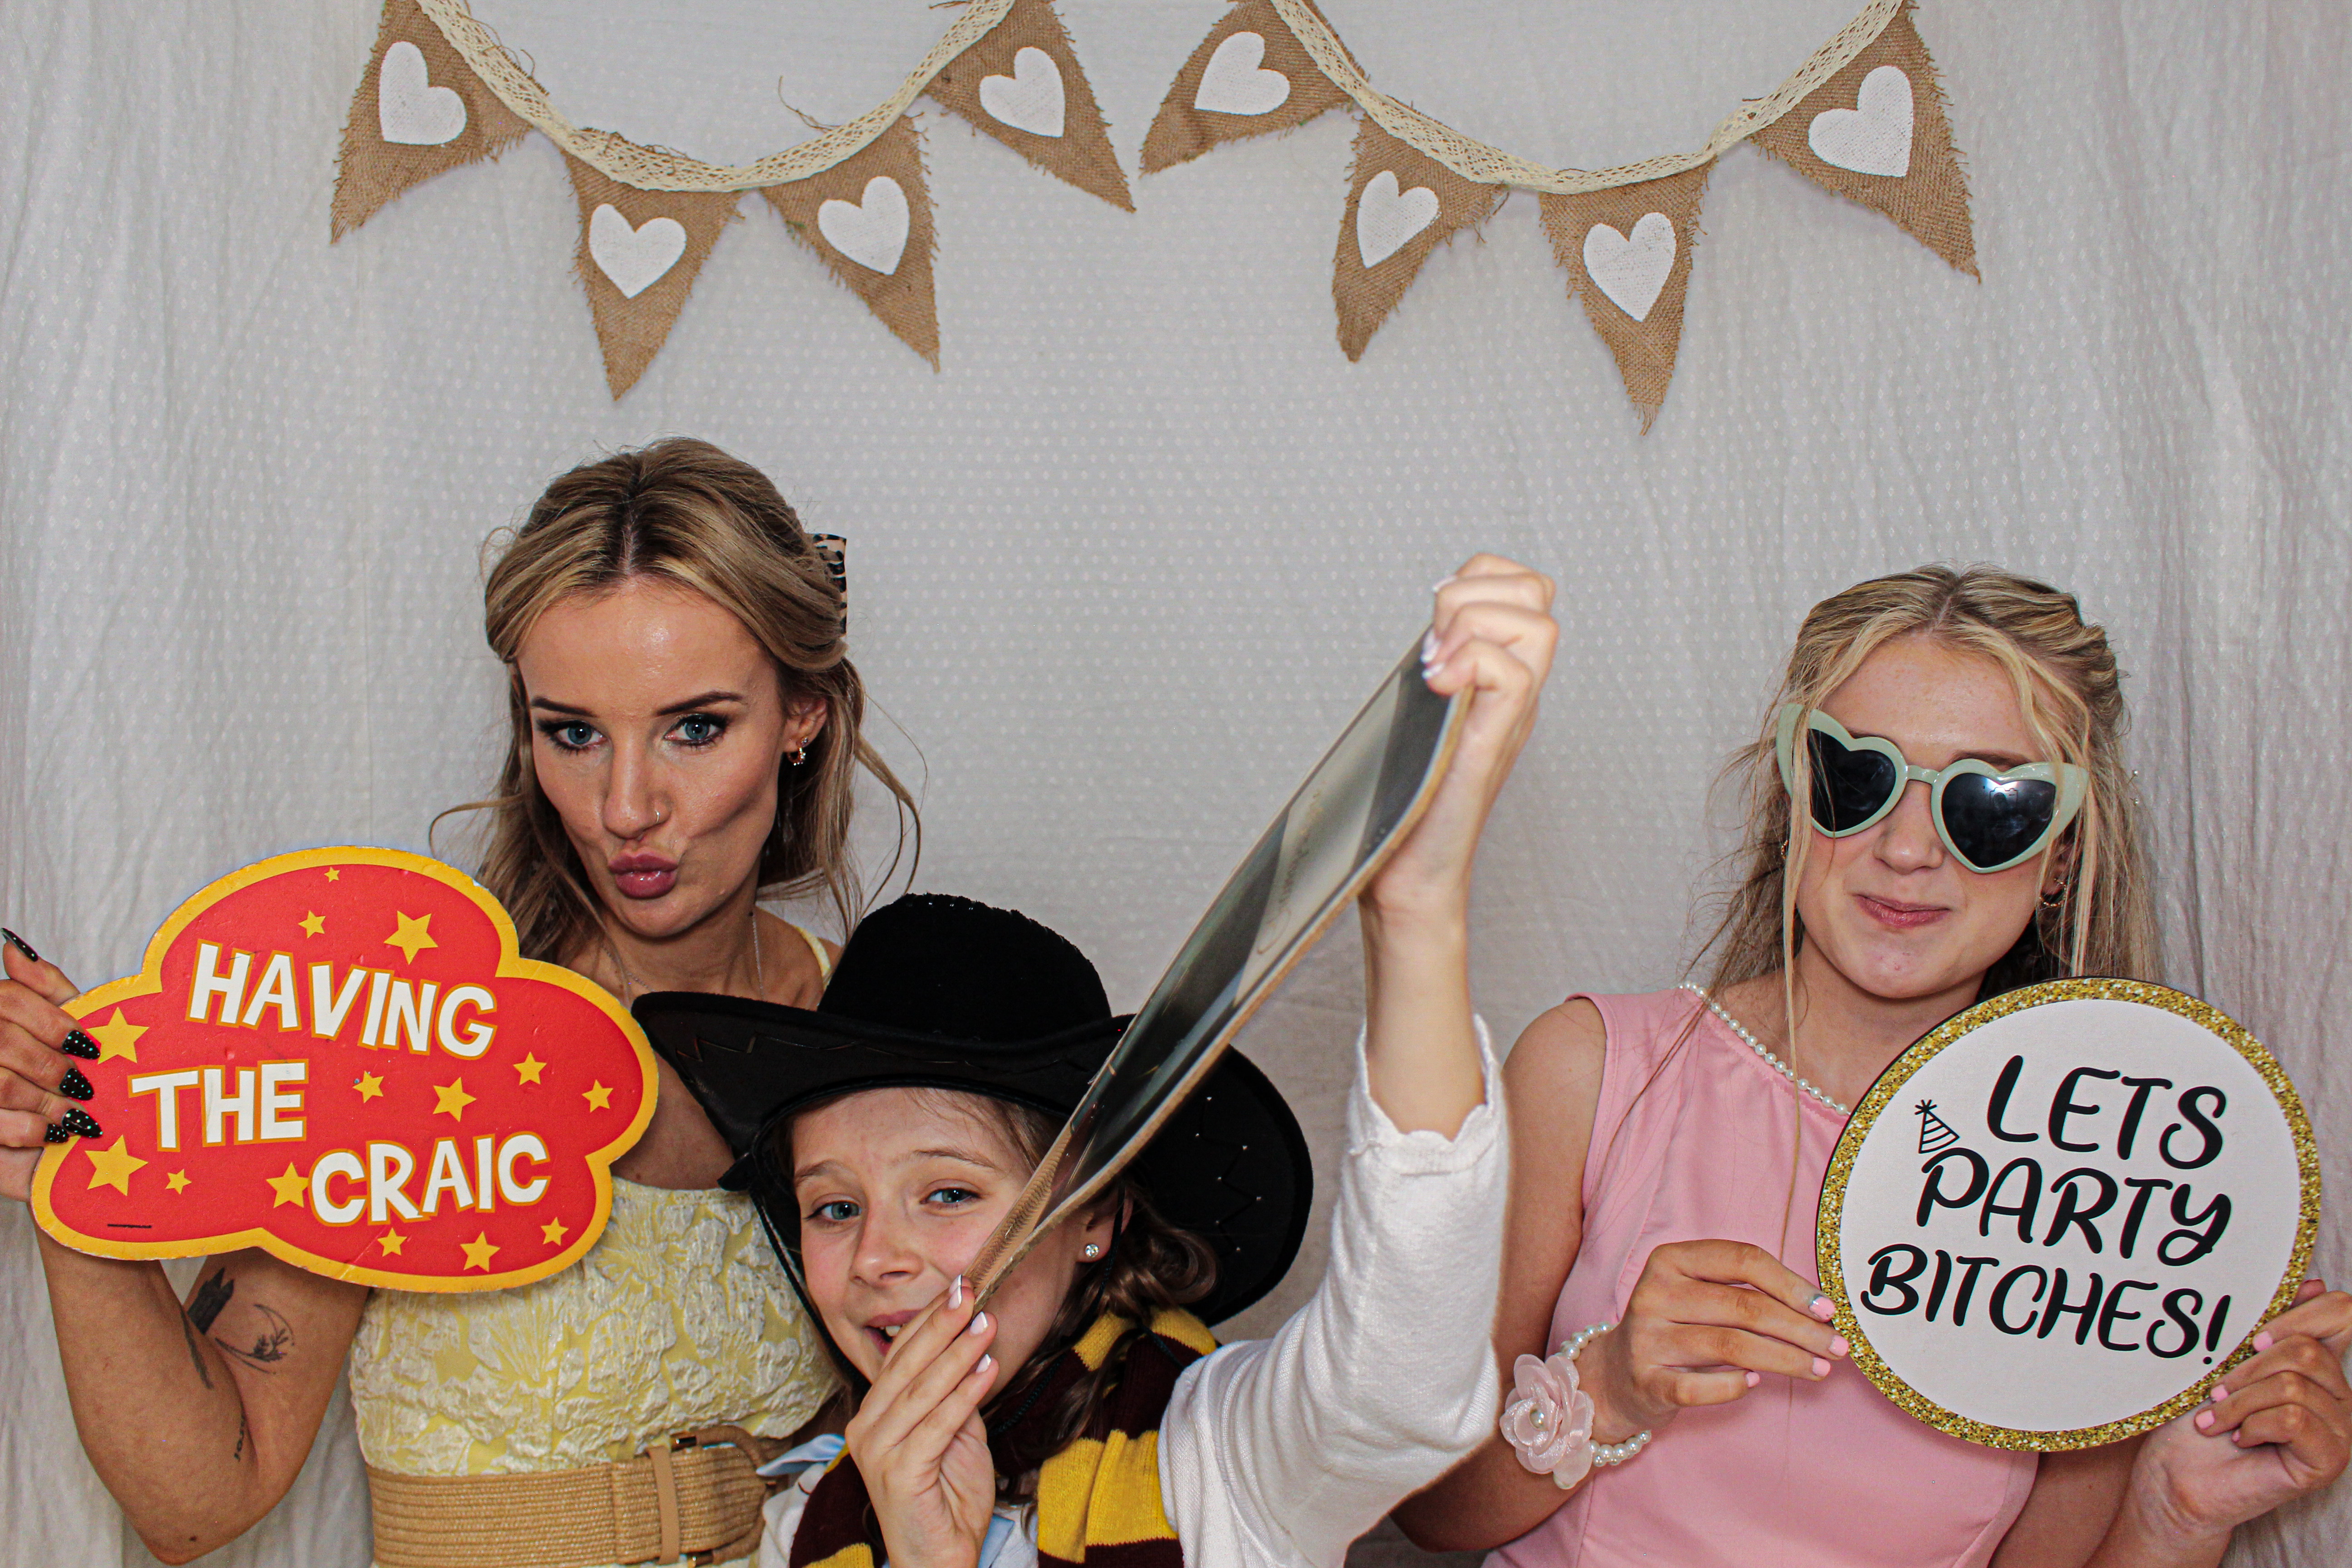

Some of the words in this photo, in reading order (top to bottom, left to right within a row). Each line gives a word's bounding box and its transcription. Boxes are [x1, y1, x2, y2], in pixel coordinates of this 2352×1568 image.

[186, 940, 497, 1059] HAVING
[129, 1060, 308, 1151] THE
[1987, 1055, 2226, 1170] LETS
[309, 1132, 550, 1226] CRAIC
[1916, 1147, 2231, 1266] PARTY
[1860, 1244, 2231, 1365] BITCHES!
